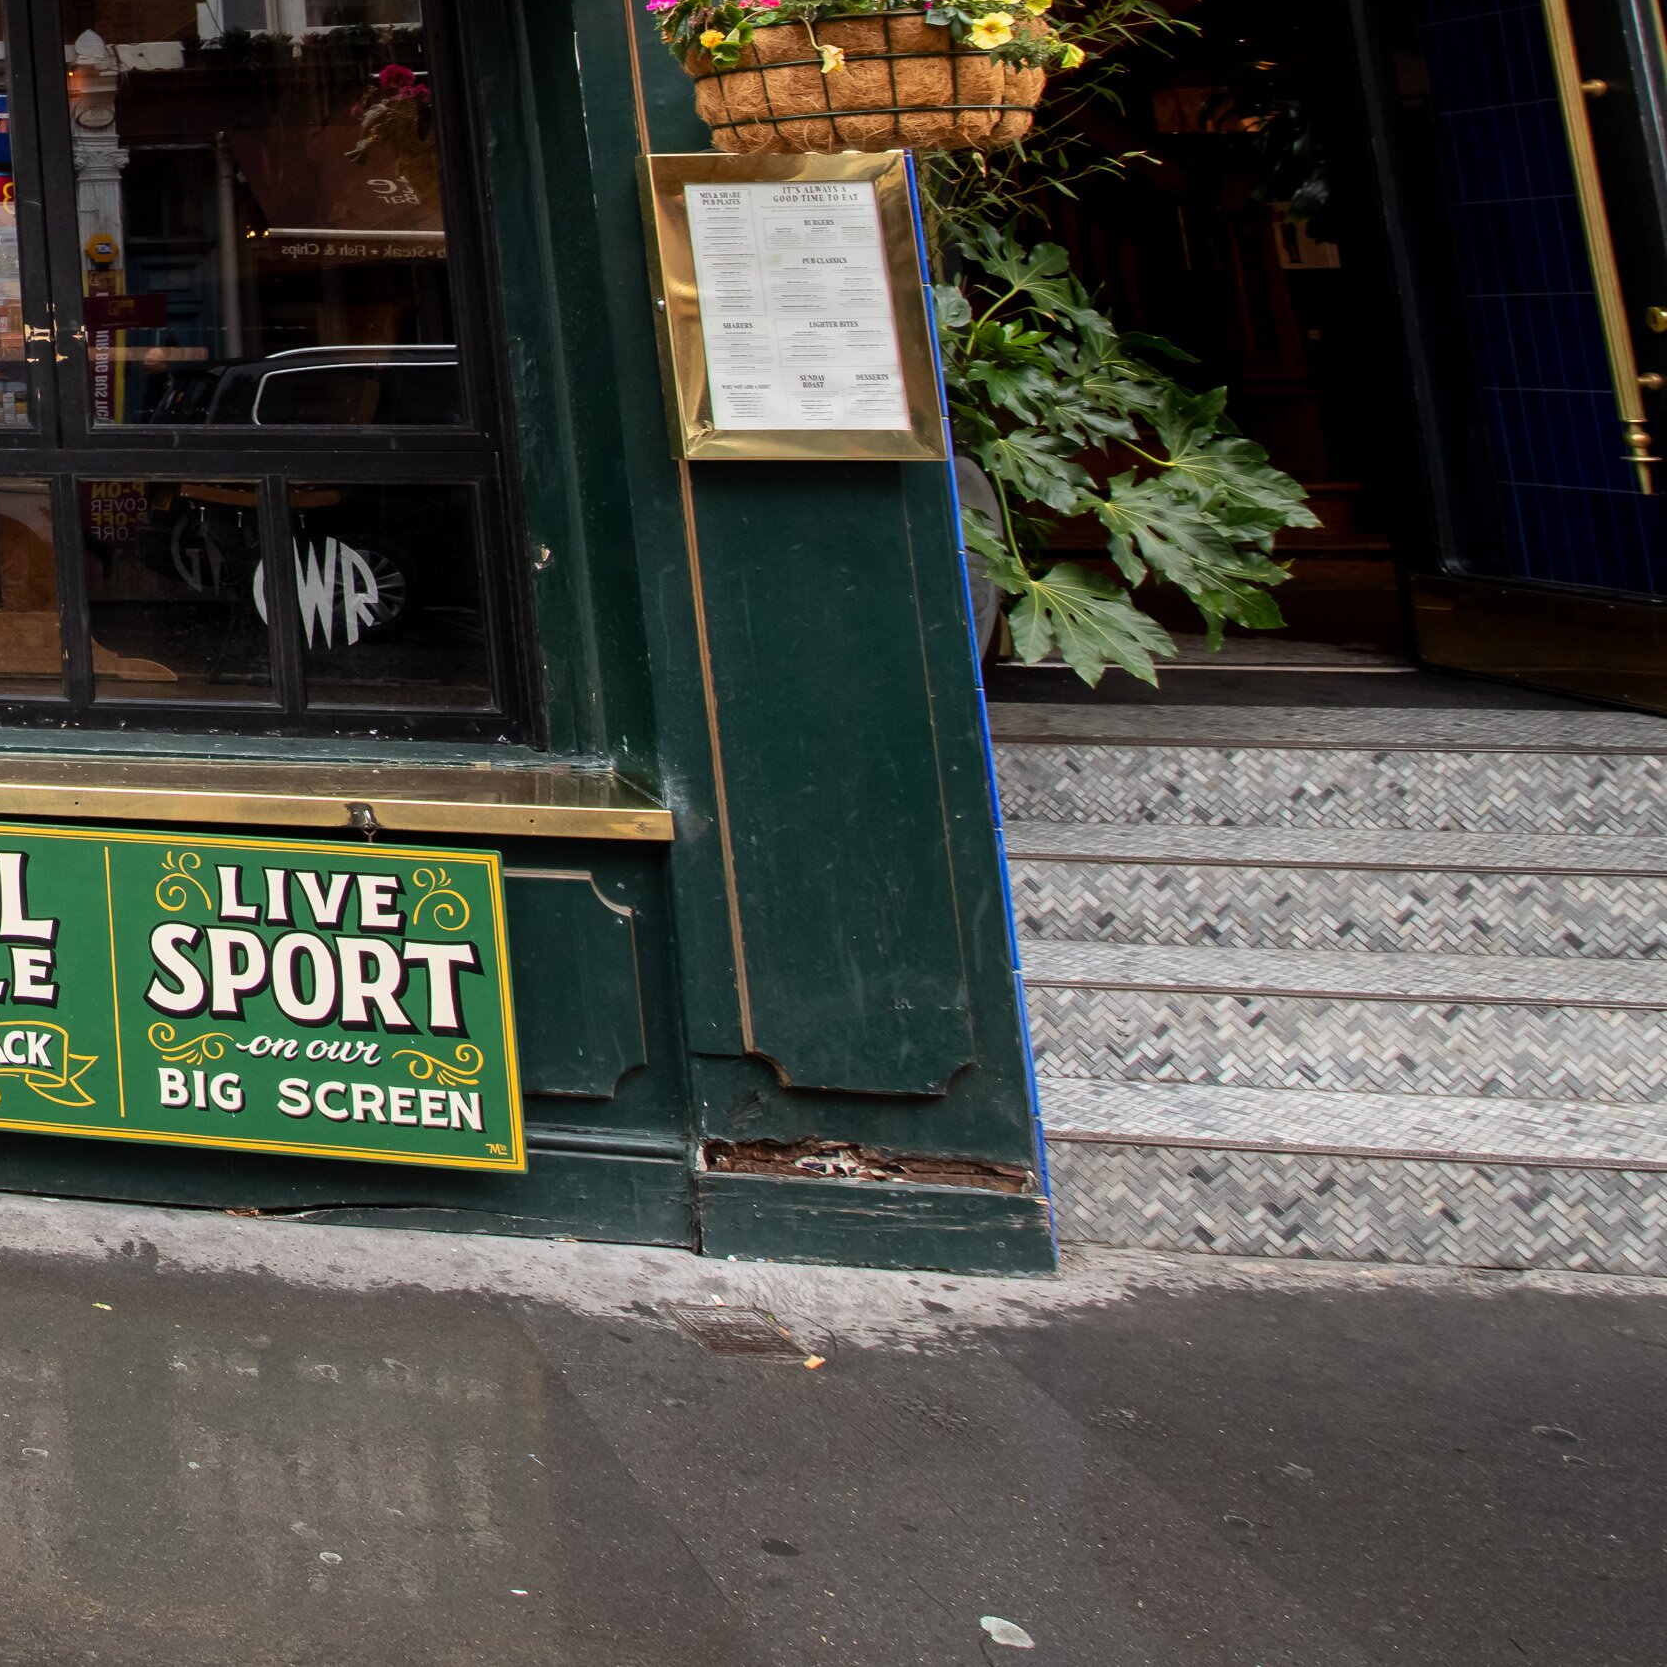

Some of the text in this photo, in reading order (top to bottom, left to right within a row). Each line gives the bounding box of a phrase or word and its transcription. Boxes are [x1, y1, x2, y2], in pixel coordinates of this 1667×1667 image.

[804, 186, 838, 194] ALWAYS
[841, 185, 847, 193] A
[702, 198, 741, 206] PUB PLATES
[773, 194, 798, 203] GOOD
[801, 194, 824, 202] TIME
[842, 193, 858, 201] EAT
[802, 257, 816, 265] PUB
[799, 374, 826, 382] SUNDAY
[802, 381, 825, 389] ROAST
[216, 864, 406, 932] LIVE
[146, 920, 485, 1035] SPORT
[235, 1032, 382, 1066] on our
[158, 1066, 486, 1133] BIG SCREEN
